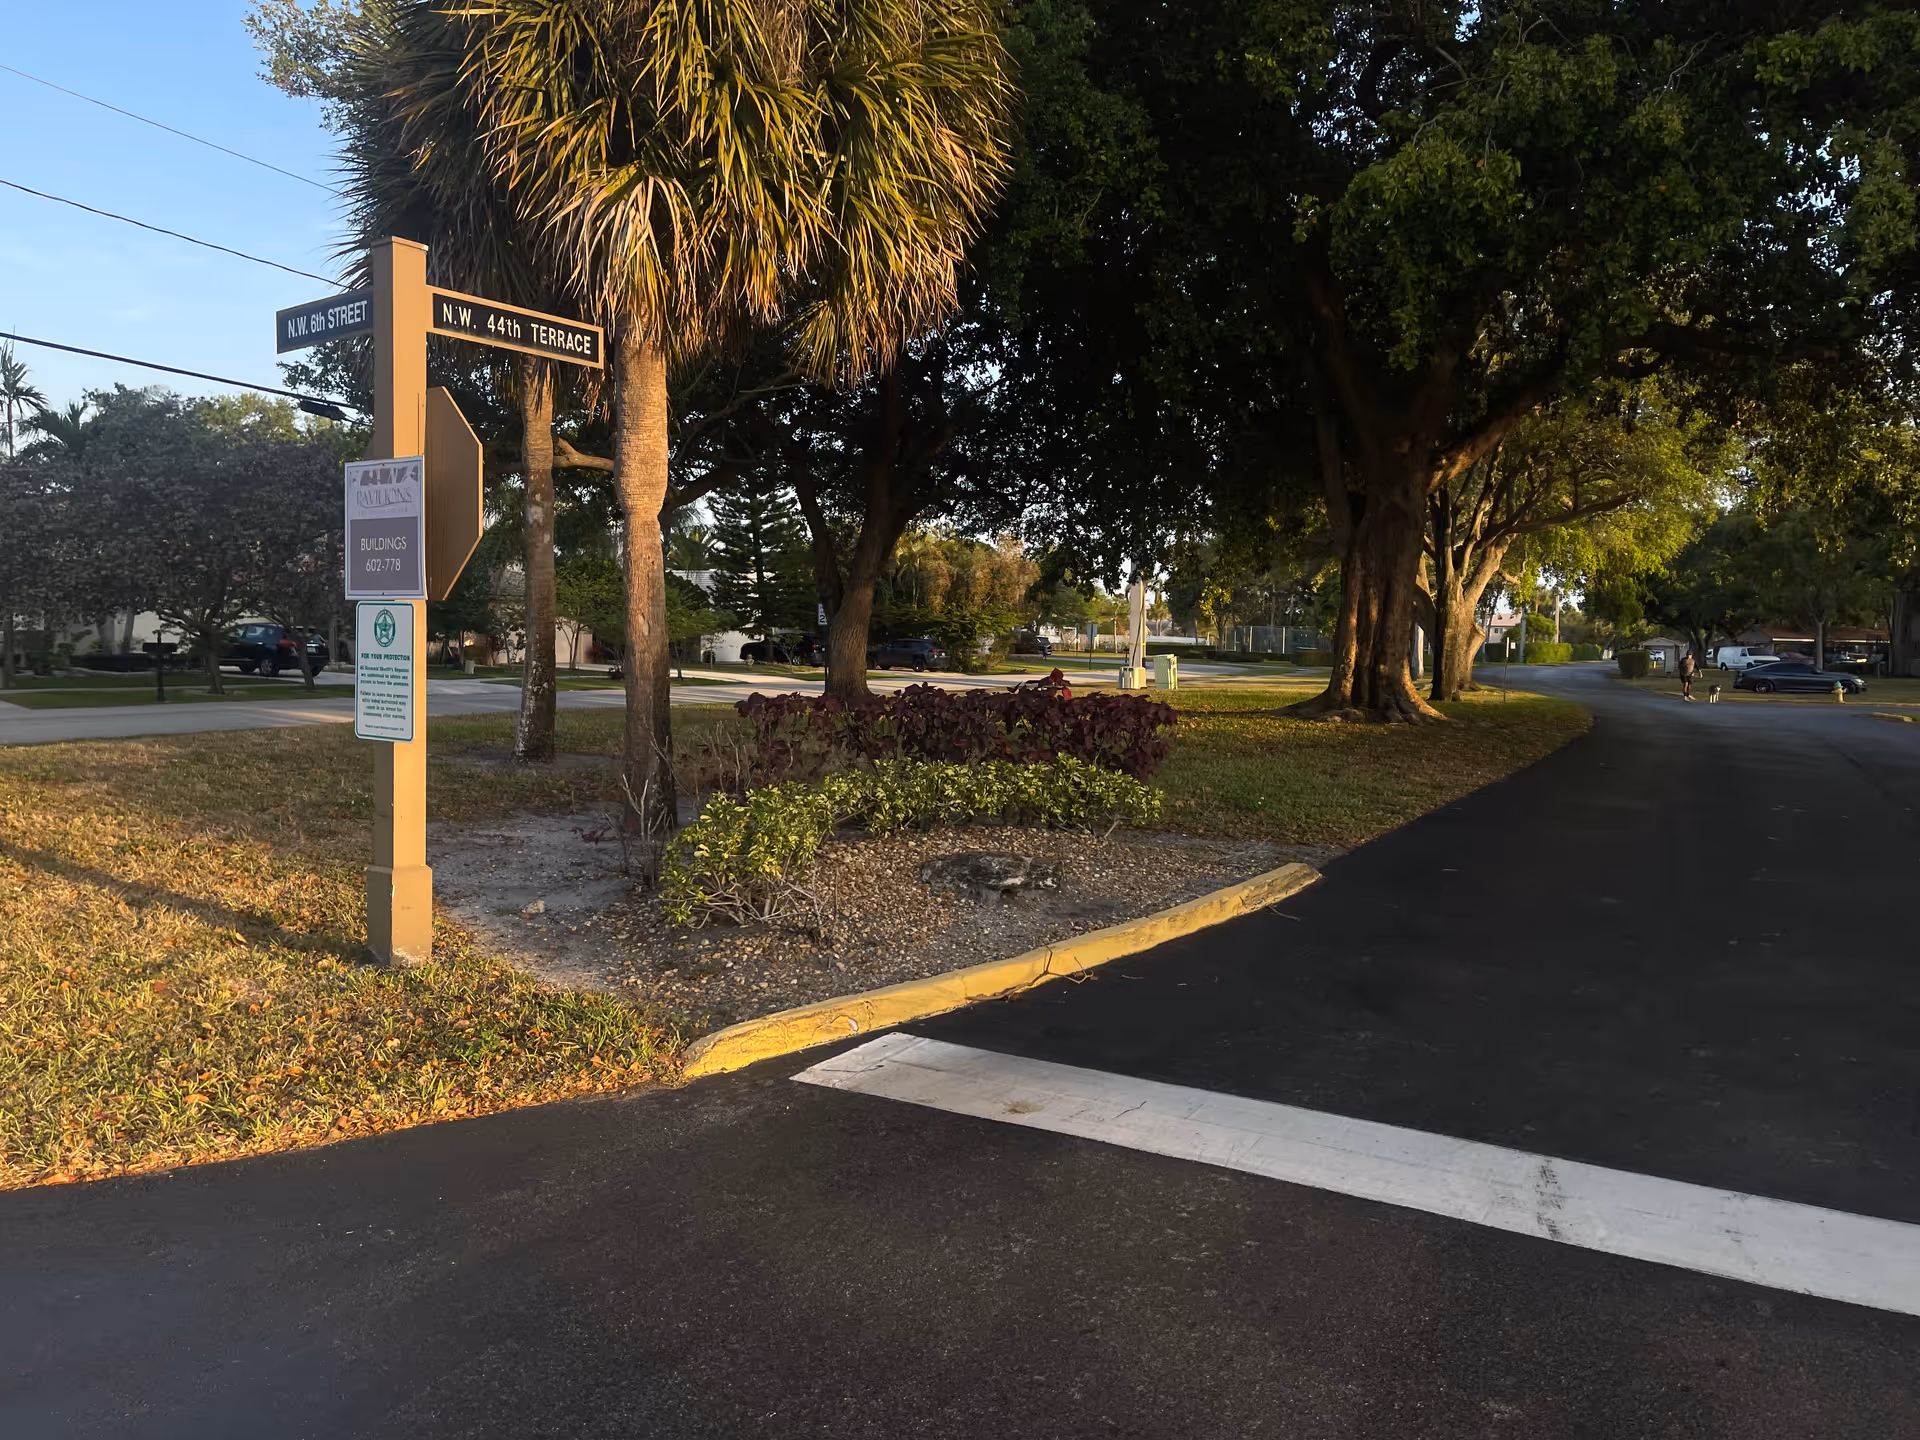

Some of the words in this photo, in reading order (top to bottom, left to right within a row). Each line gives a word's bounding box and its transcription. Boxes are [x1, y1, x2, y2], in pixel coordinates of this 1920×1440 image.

[288, 315, 308, 339] N.W.
[310, 311, 325, 333] 6th
[328, 300, 368, 329] STREET
[443, 302, 477, 329] N.W.
[487, 313, 521, 339] 44th
[530, 323, 591, 355] TERRACE
[360, 536, 407, 551] BUILDINGS
[365, 558, 401, 572] 602-778
